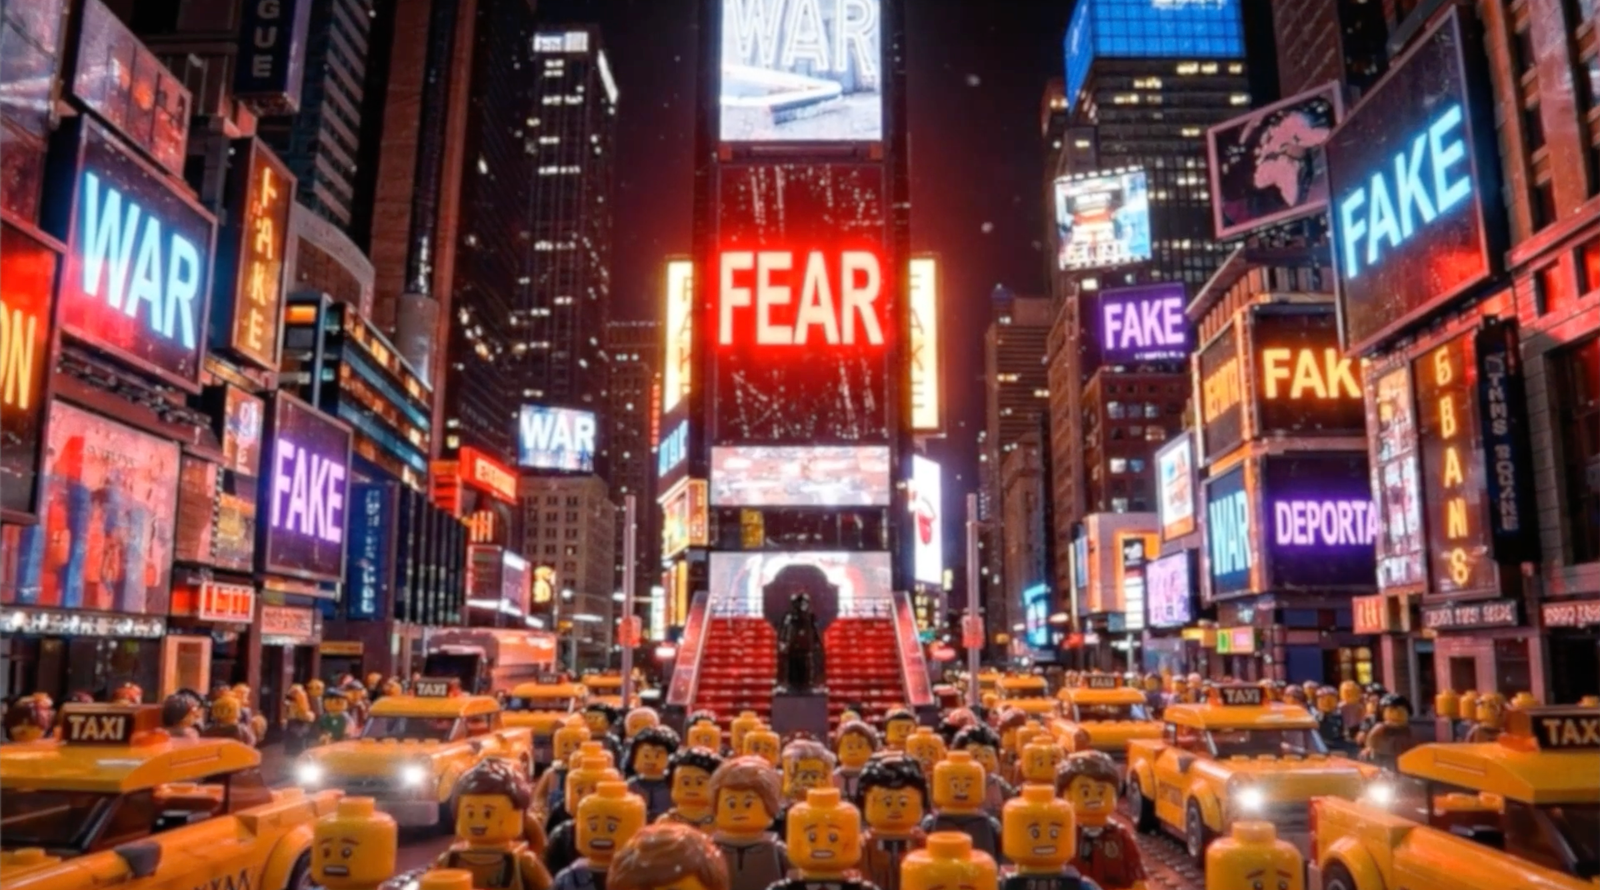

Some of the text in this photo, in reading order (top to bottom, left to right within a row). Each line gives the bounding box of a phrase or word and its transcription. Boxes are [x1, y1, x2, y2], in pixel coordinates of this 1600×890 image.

[724, 0, 877, 74] WAR
[1340, 104, 1472, 279] FAKE
[84, 171, 200, 351] WAR
[718, 250, 885, 346] FEAR
[1104, 297, 1184, 350] FAKE
[520, 410, 596, 454] WAR
[271, 438, 346, 544] FAKE
[1209, 489, 1251, 576] WAR
[416, 682, 448, 696] TAXI
[1223, 688, 1261, 704] TAXI
[67, 715, 126, 740] TAXI
